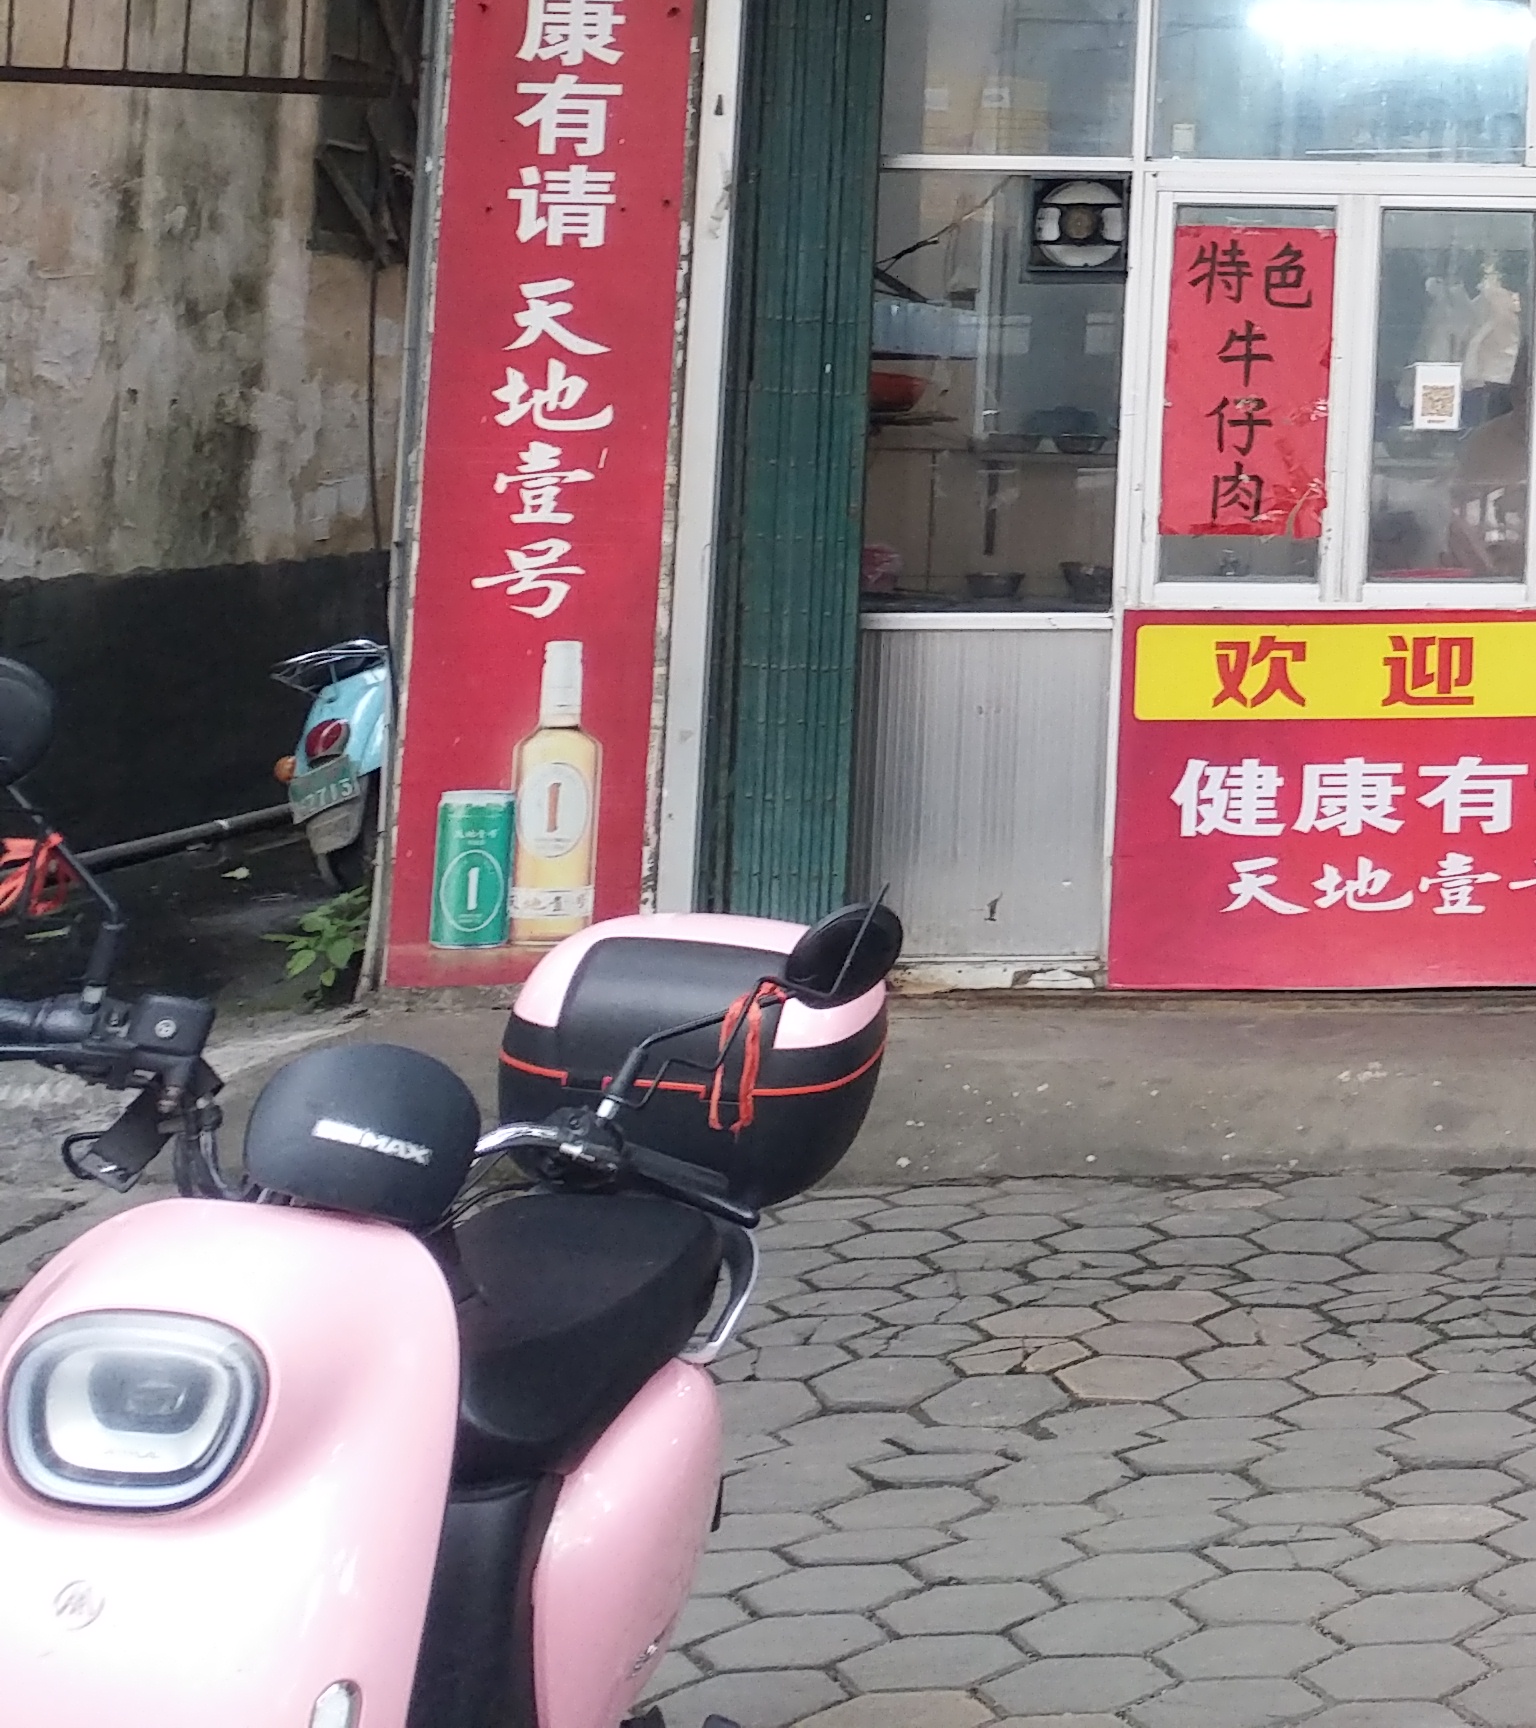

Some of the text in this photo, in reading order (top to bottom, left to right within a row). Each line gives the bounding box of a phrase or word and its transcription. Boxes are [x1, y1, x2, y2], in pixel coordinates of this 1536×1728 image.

[1188, 240, 1314, 309] 特色
[471, 277, 613, 620] 天地壹号
[1205, 320, 1273, 522] 牛仔肉
